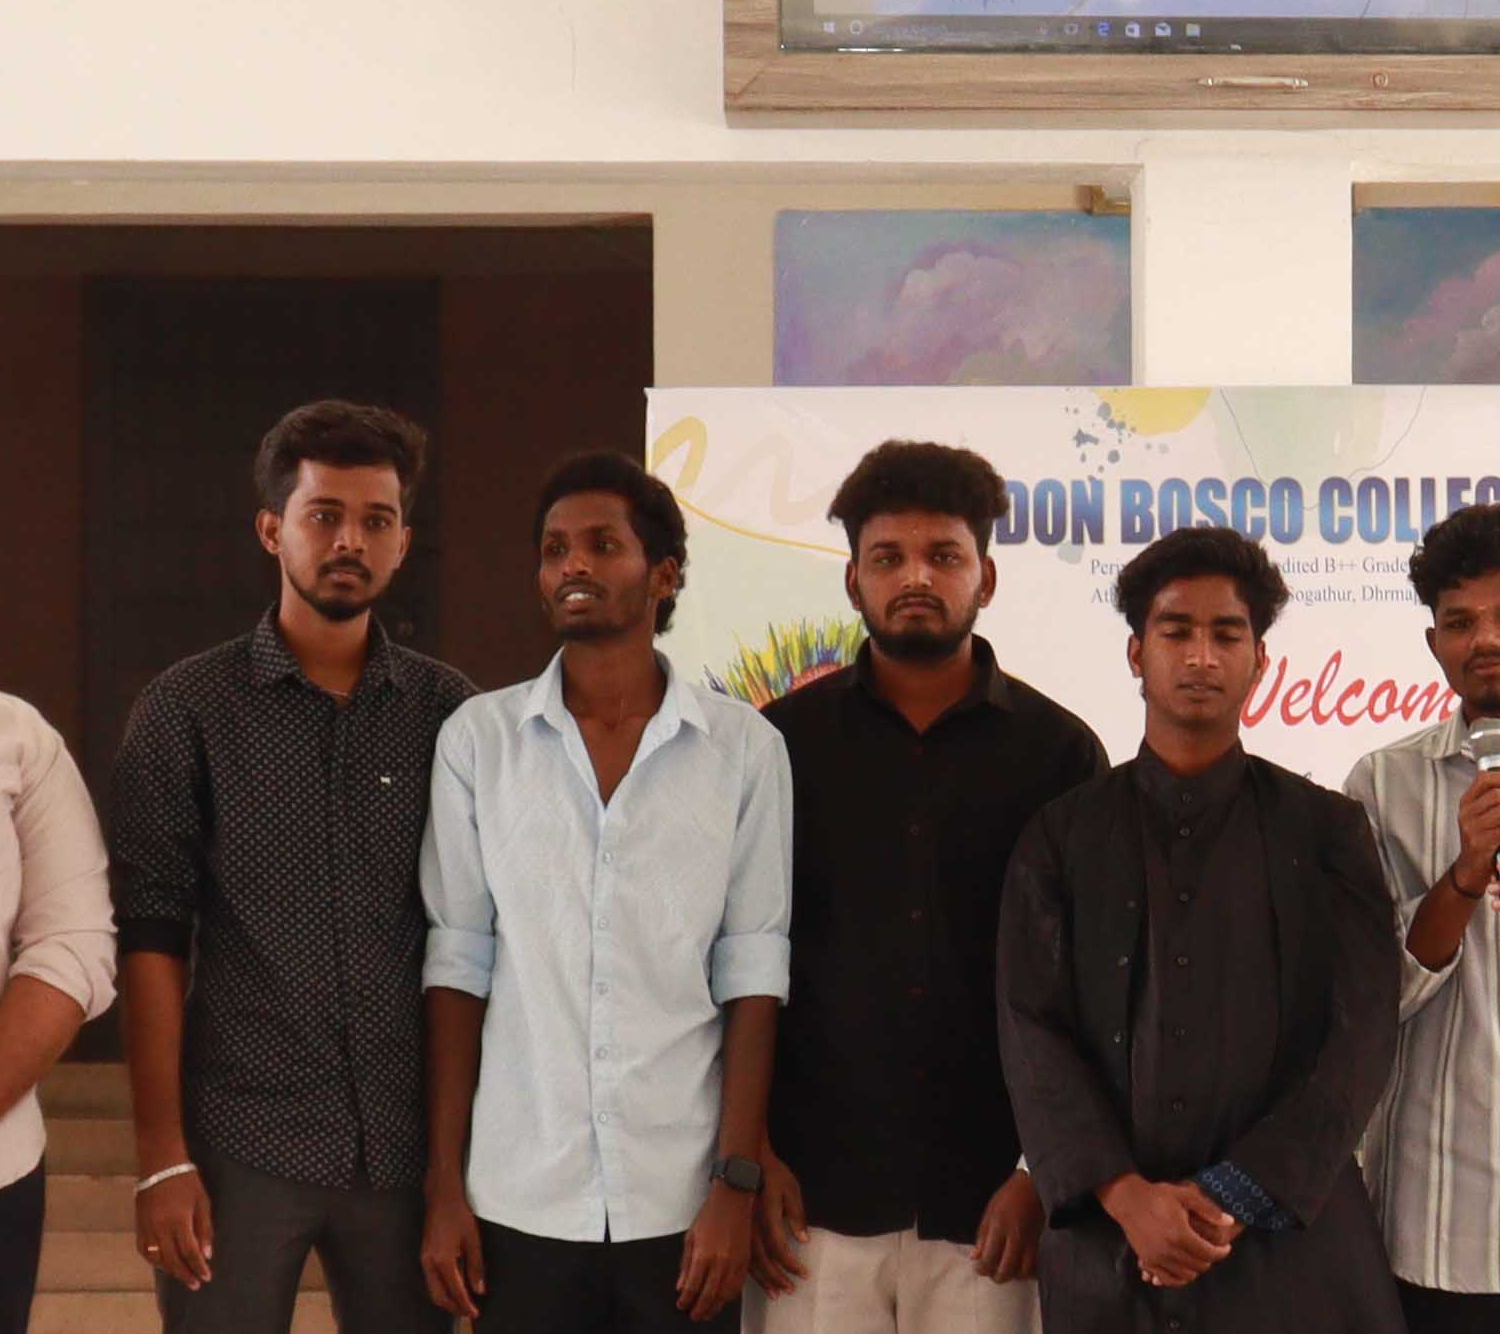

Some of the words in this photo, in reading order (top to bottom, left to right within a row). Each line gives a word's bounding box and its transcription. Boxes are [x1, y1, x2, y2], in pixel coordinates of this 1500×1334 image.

[994, 478, 1105, 545] DON
[1119, 477, 1304, 545] BOSCO
[1325, 557, 1357, 573] B++
